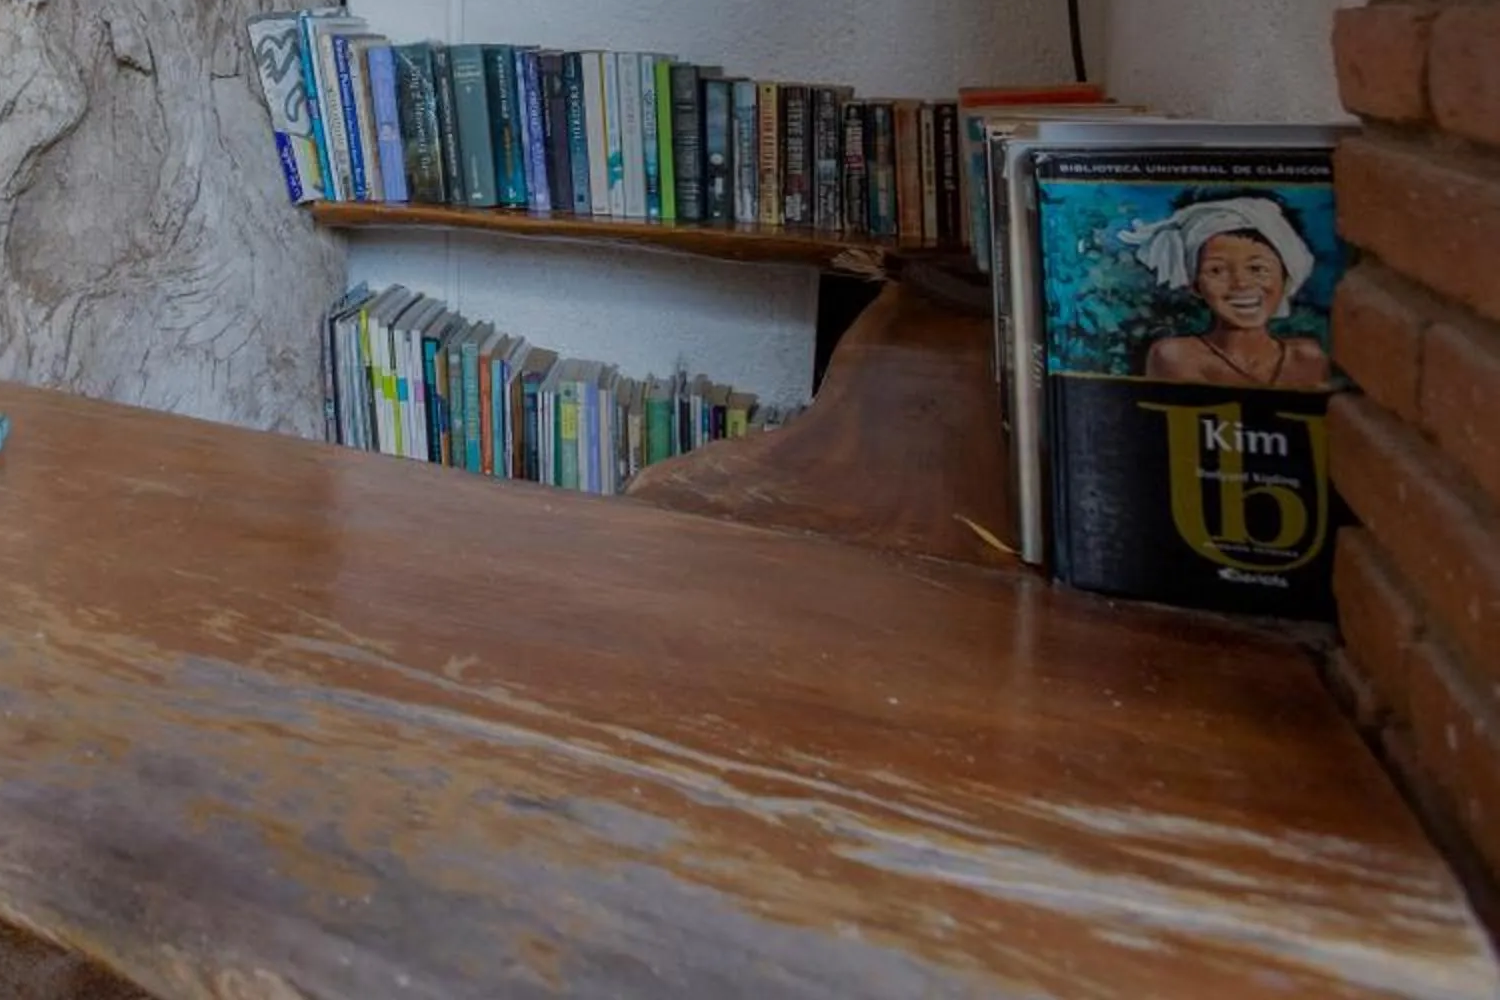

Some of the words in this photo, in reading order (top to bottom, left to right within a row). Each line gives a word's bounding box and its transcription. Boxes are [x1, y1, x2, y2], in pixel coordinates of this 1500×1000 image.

[1059, 163, 1141, 174] BIBLIOTECA
[1146, 163, 1227, 175] UNIVERSAL
[1233, 165, 1252, 175] DE
[1203, 418, 1288, 457] Kim
